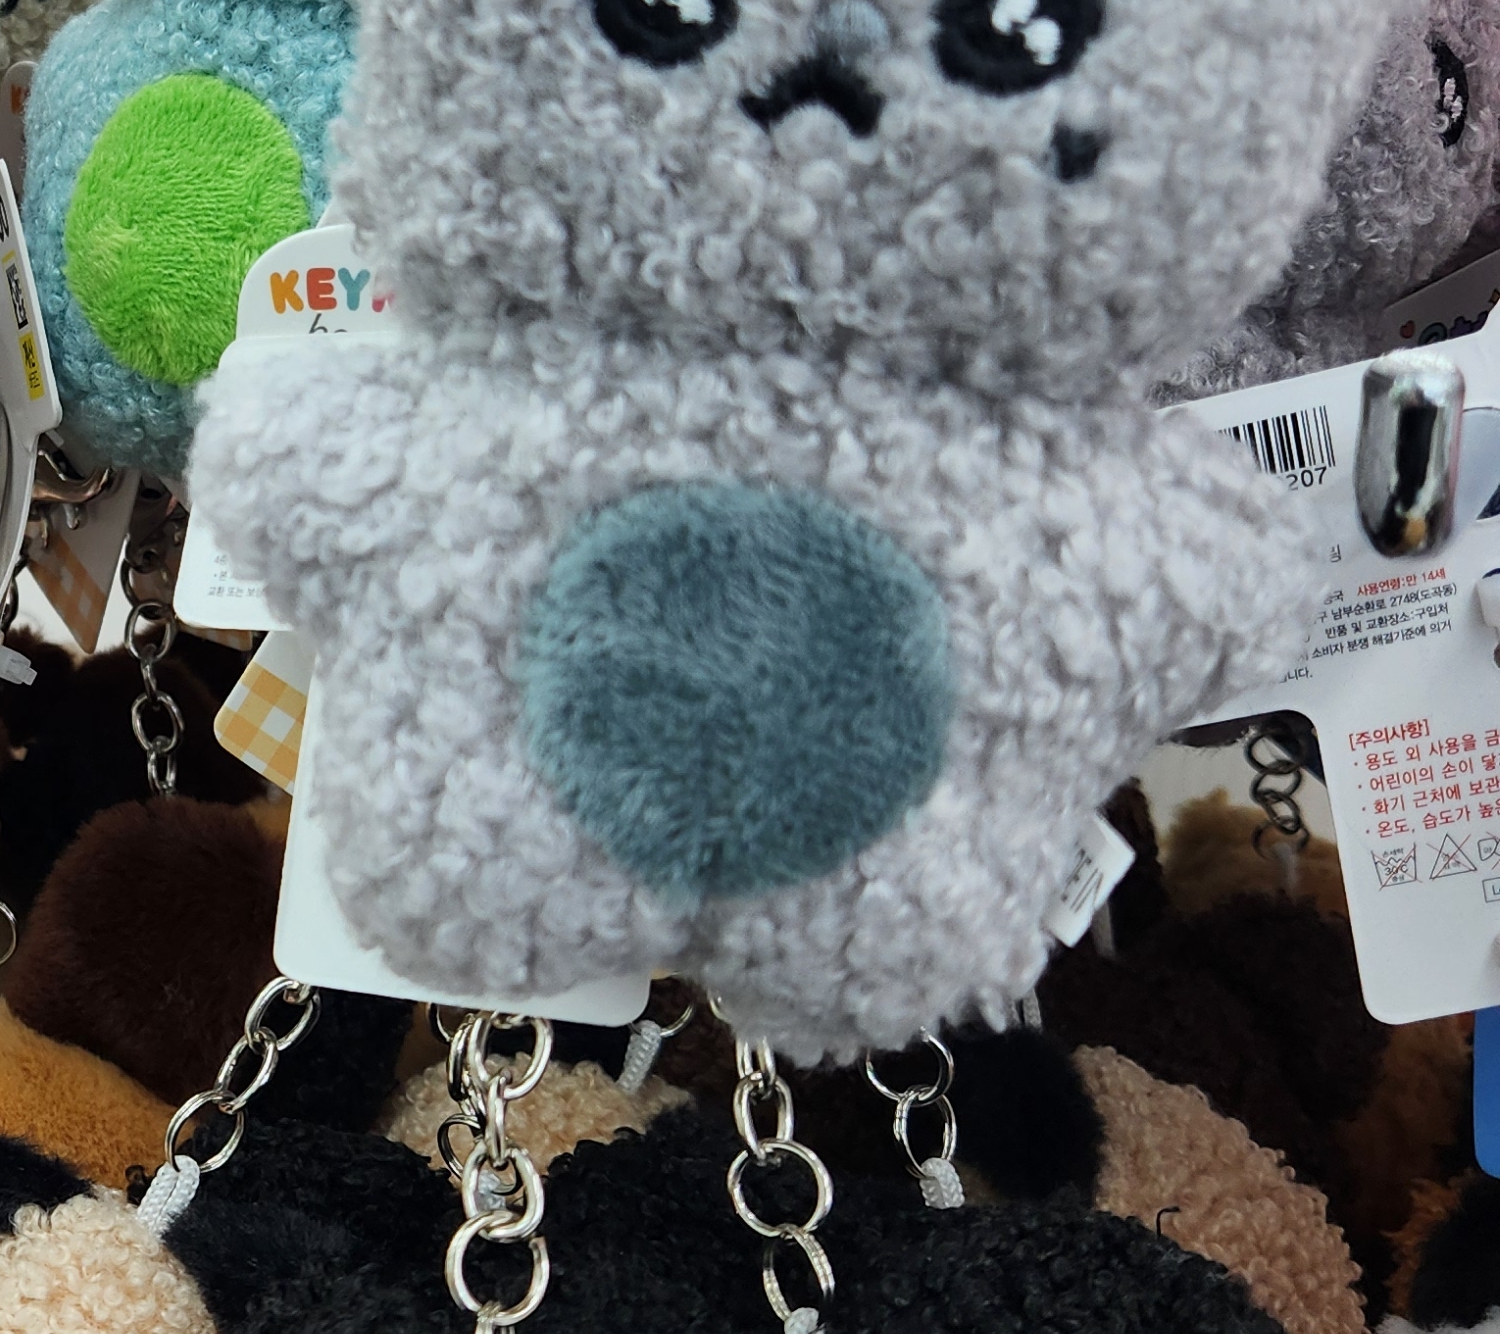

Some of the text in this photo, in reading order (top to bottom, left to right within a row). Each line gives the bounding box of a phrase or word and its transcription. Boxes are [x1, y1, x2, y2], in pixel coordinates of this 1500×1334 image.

[1357, 573, 1417, 597] 사용연령:만
[1325, 603, 1449, 640] 반품 및 교환장소:구입처
[1331, 599, 1387, 621] 남부순환로
[1311, 643, 1344, 659] 소비자
[1347, 638, 1369, 653] 분쟁
[1372, 627, 1426, 647] 해결기준에
[1430, 619, 1452, 633] 의거
[1279, 667, 1313, 684] 니다.
[1349, 718, 1430, 751] [주의사항]
[1366, 750, 1398, 771] 용도
[1406, 745, 1421, 762] 외
[1429, 733, 1477, 757] 사용을
[1370, 753, 1500, 792] 어린이의 손이 닿
[1374, 795, 1406, 815] 화기
[1413, 783, 1461, 808] 근처에
[1377, 818, 1415, 838] 온도,
[1423, 805, 1471, 829] 습도가
